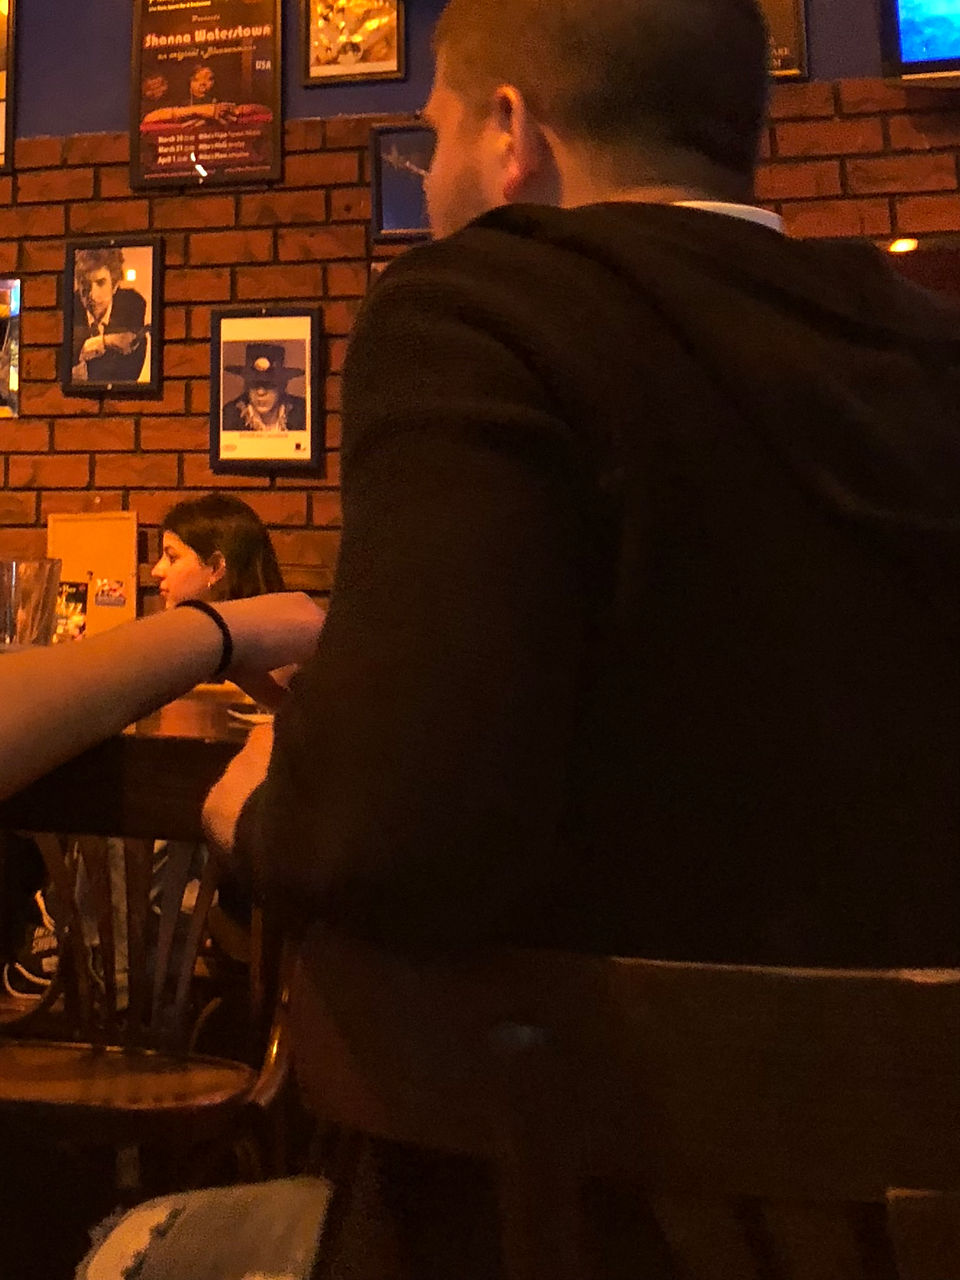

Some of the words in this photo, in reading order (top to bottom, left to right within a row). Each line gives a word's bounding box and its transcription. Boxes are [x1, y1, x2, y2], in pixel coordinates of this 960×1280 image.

[144, 32, 191, 49] Shanna
[194, 23, 272, 43] Waterstown
[256, 60, 272, 70] USA
